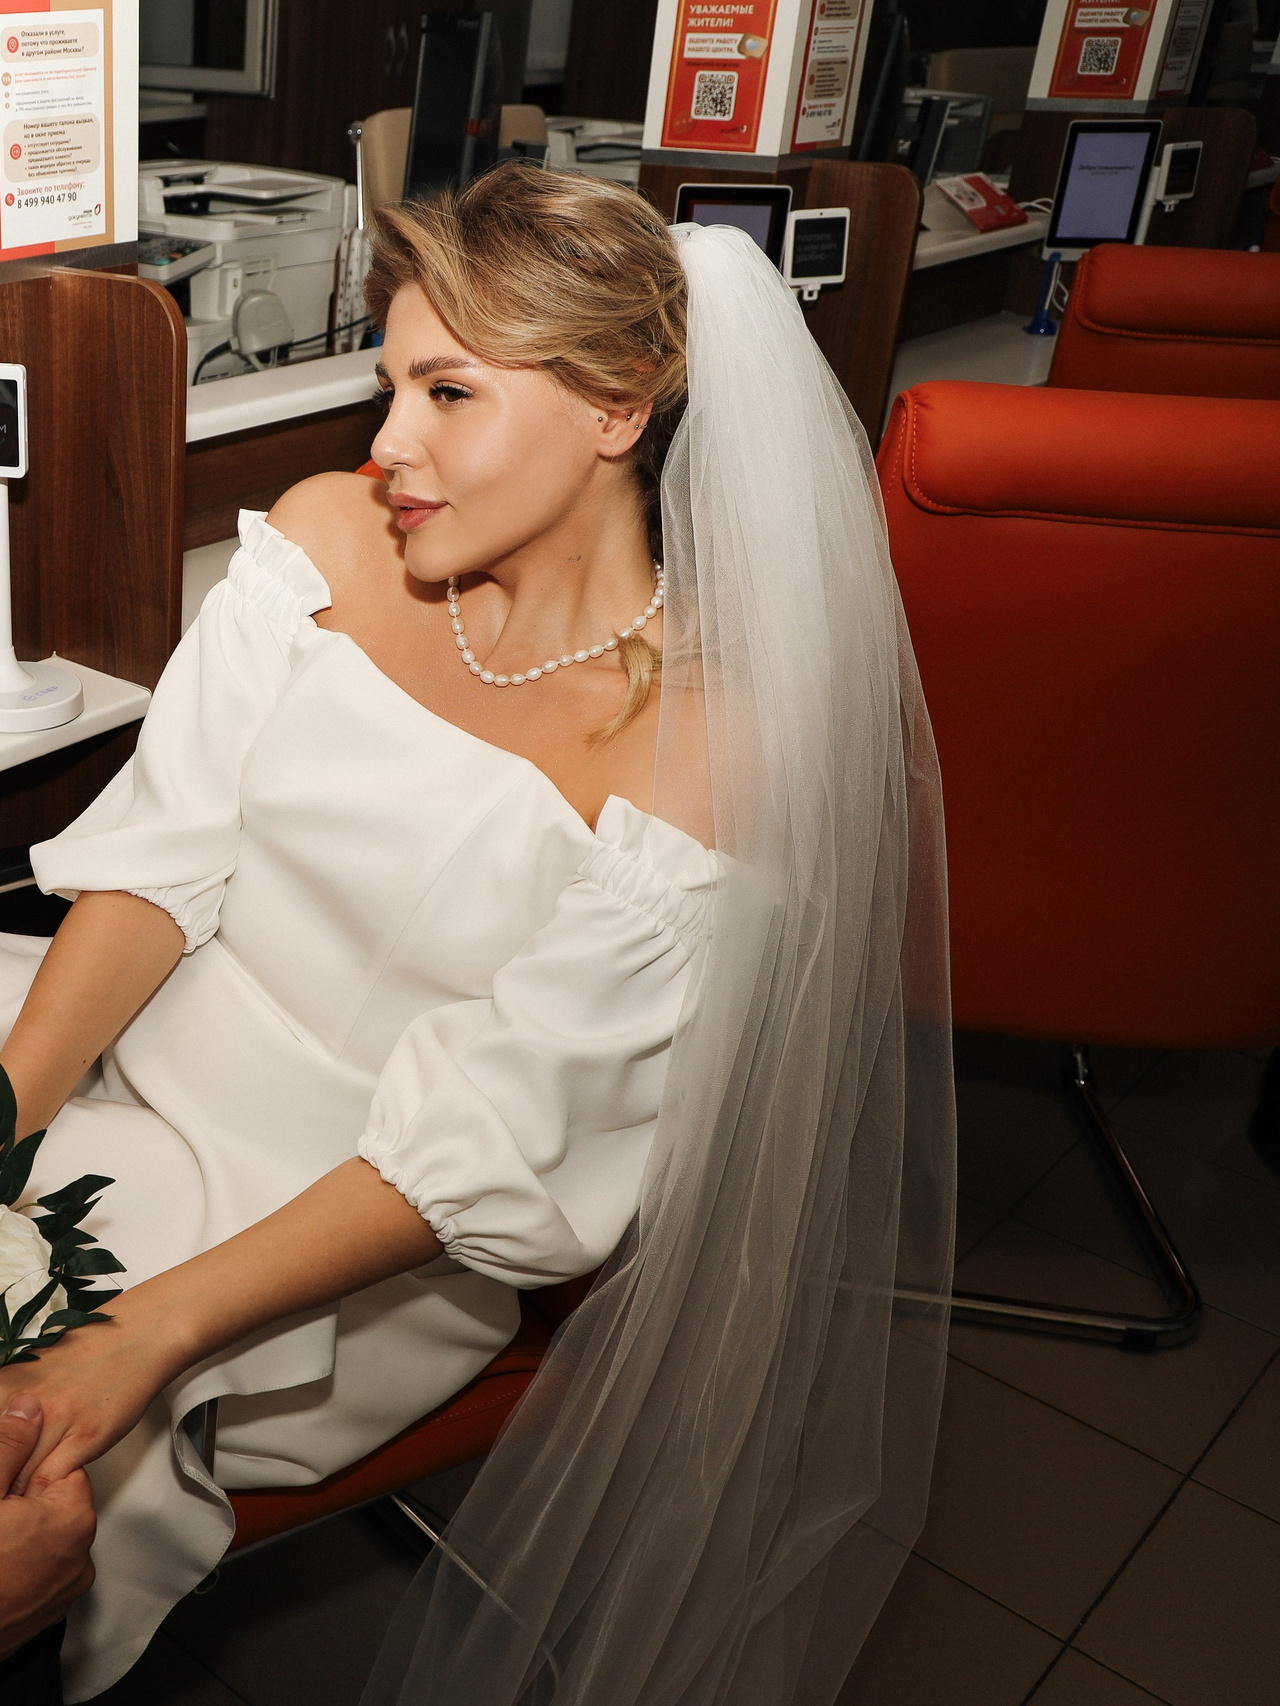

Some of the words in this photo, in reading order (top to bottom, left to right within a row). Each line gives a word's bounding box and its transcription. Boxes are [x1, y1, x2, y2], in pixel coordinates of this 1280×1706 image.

[689, 4, 754, 15] УВАЖАЕМЫЕ
[687, 17, 734, 28] ЖИТЕЛИ!
[49, 38, 77, 46] проживаете
[26, 49, 43, 57] другом
[17, 186, 42, 196] Звоните
[44, 185, 52, 193] по
[54, 181, 85, 191] телефону:
[17, 199, 22, 209] 8
[24, 196, 38, 208] 499
[41, 195, 54, 205] 940
[57, 193, 65, 202] 47
[68, 192, 77, 201] 90
